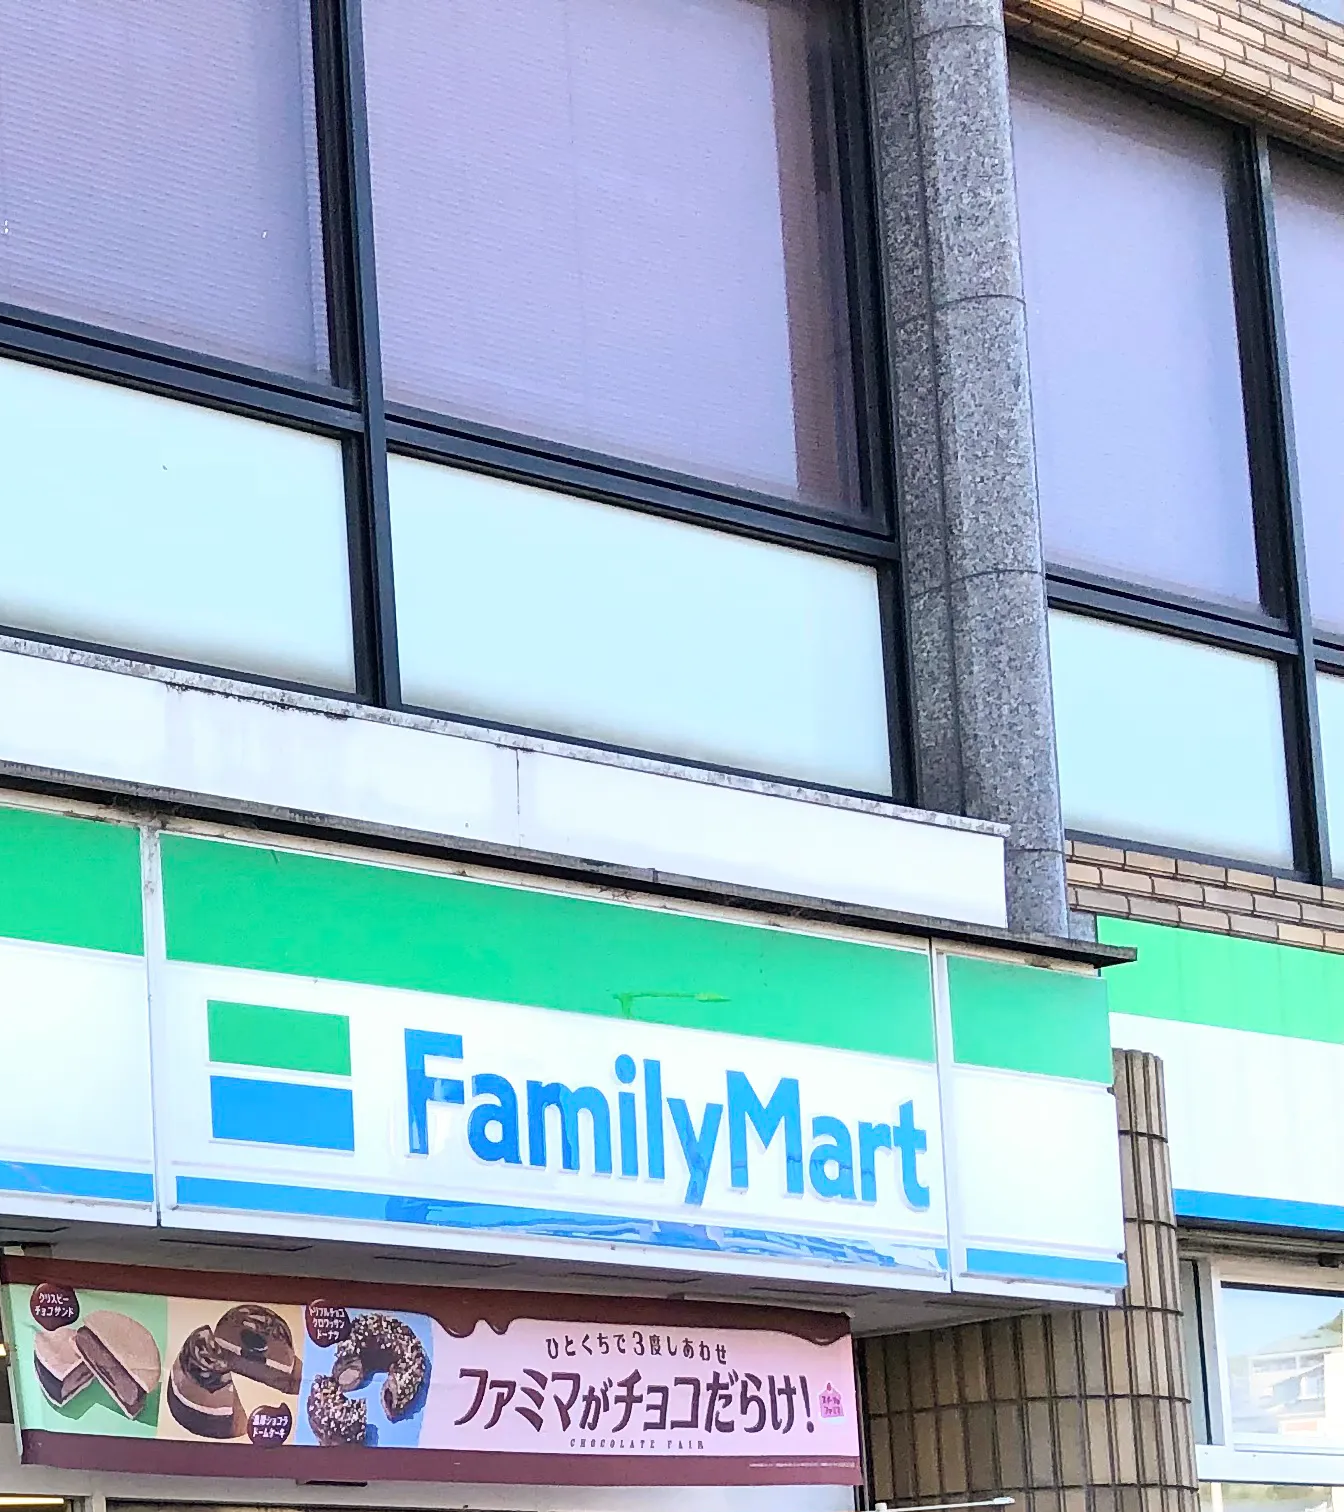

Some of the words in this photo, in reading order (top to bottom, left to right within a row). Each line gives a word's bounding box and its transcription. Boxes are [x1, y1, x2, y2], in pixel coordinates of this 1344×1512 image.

[404, 1028, 929, 1210] FamilyMart
[39, 1294, 69, 1305] クリスピー
[35, 1305, 75, 1318] チョコサンド
[316, 1328, 340, 1340] ドーナツ
[546, 1330, 728, 1366] ひとくちで3度しあわせ
[569, 1437, 656, 1450] CHOCOLATE
[666, 1439, 706, 1450] FAIR
